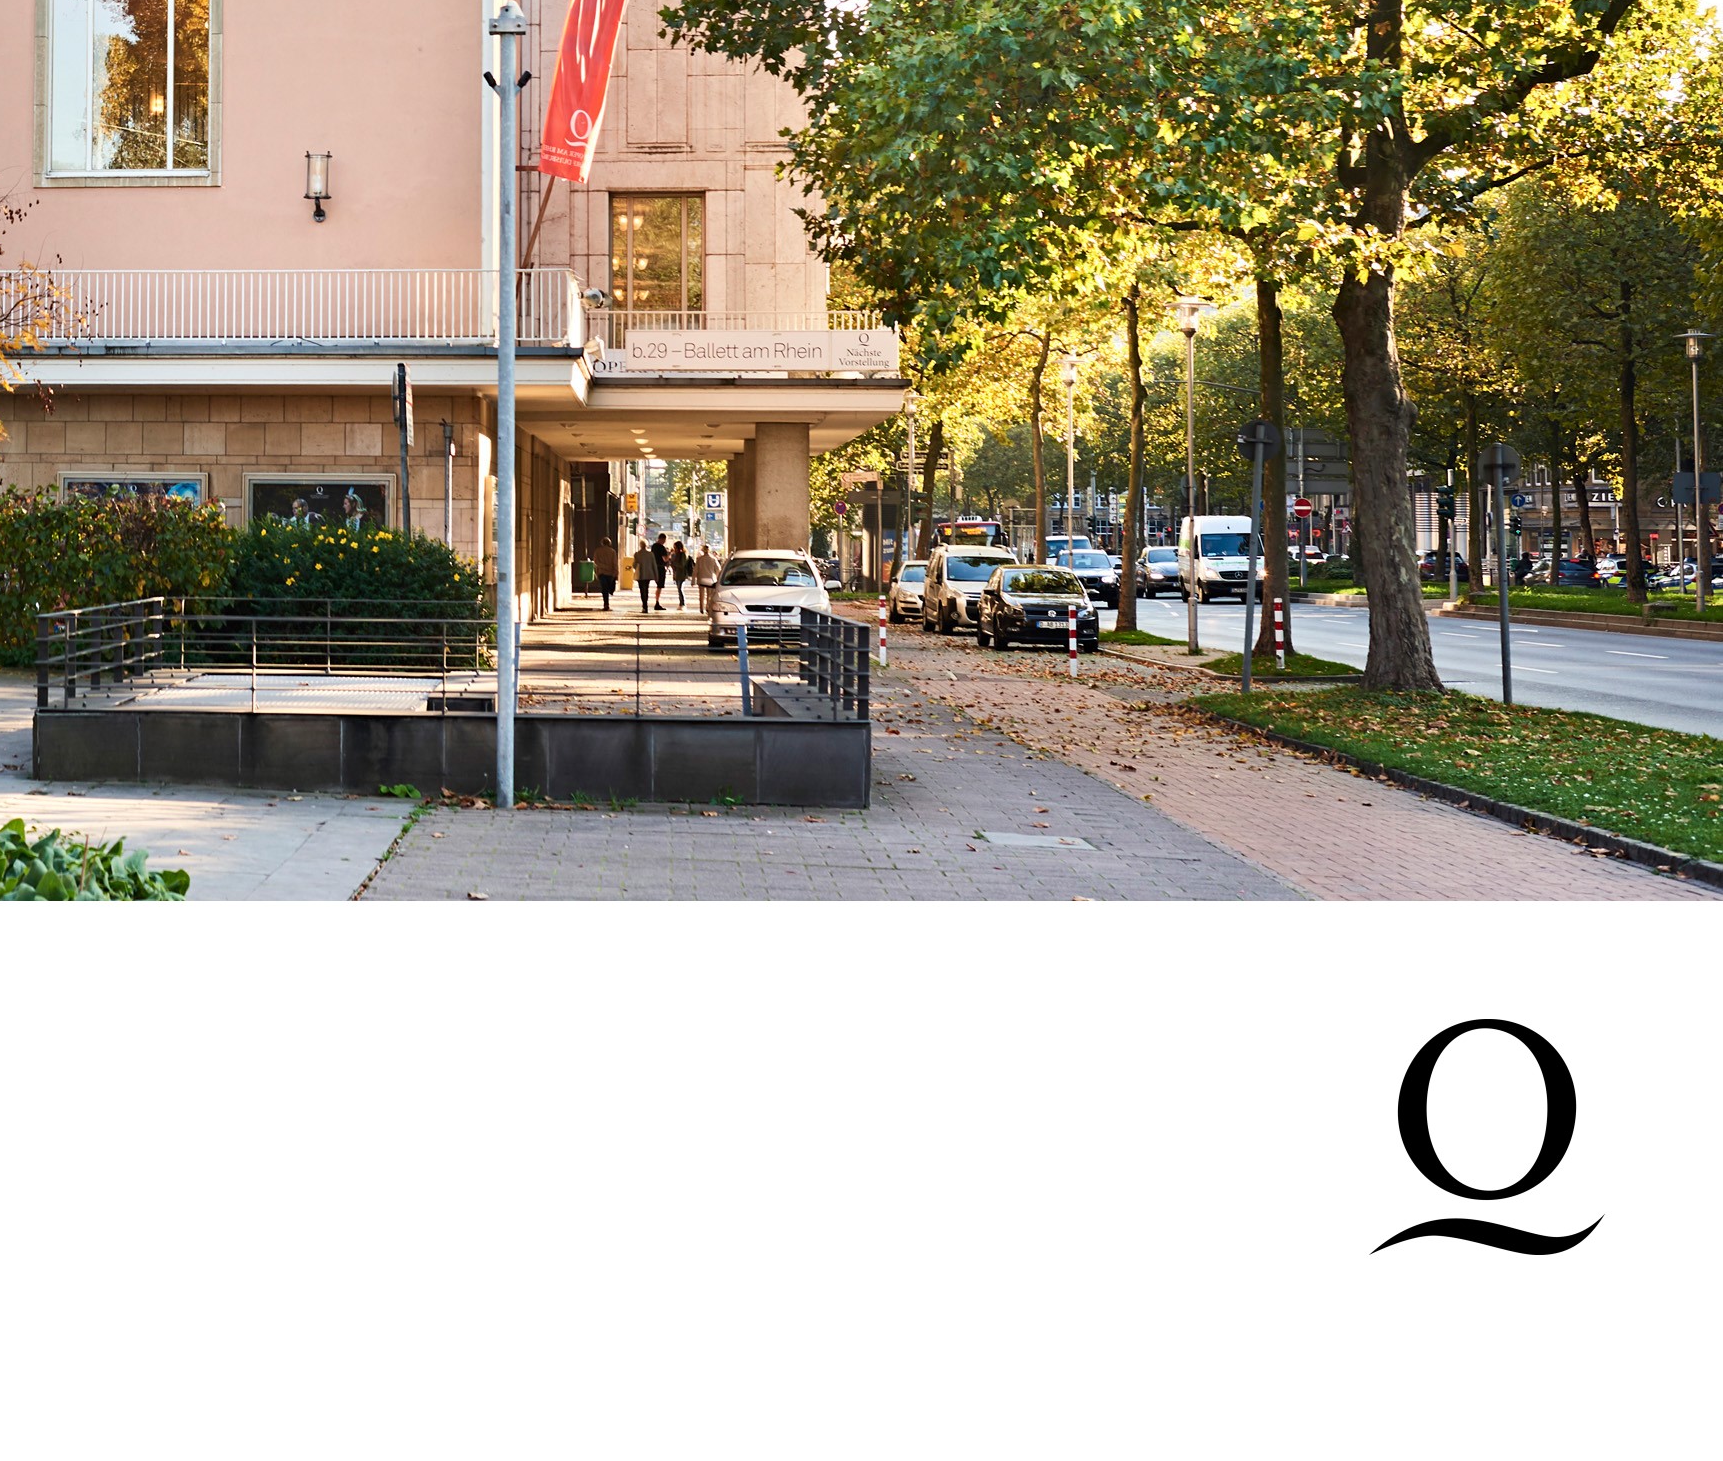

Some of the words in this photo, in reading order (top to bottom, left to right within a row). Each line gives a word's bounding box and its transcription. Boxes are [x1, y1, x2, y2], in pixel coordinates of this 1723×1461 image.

[858, 332, 870, 347] Q
[632, 342, 668, 359] b.29
[684, 342, 739, 359] Ballett
[742, 346, 770, 359] am
[774, 342, 823, 359] Rhein
[846, 348, 882, 357] Nächste
[838, 358, 890, 368] Vorstellung
[708, 495, 720, 507] U
